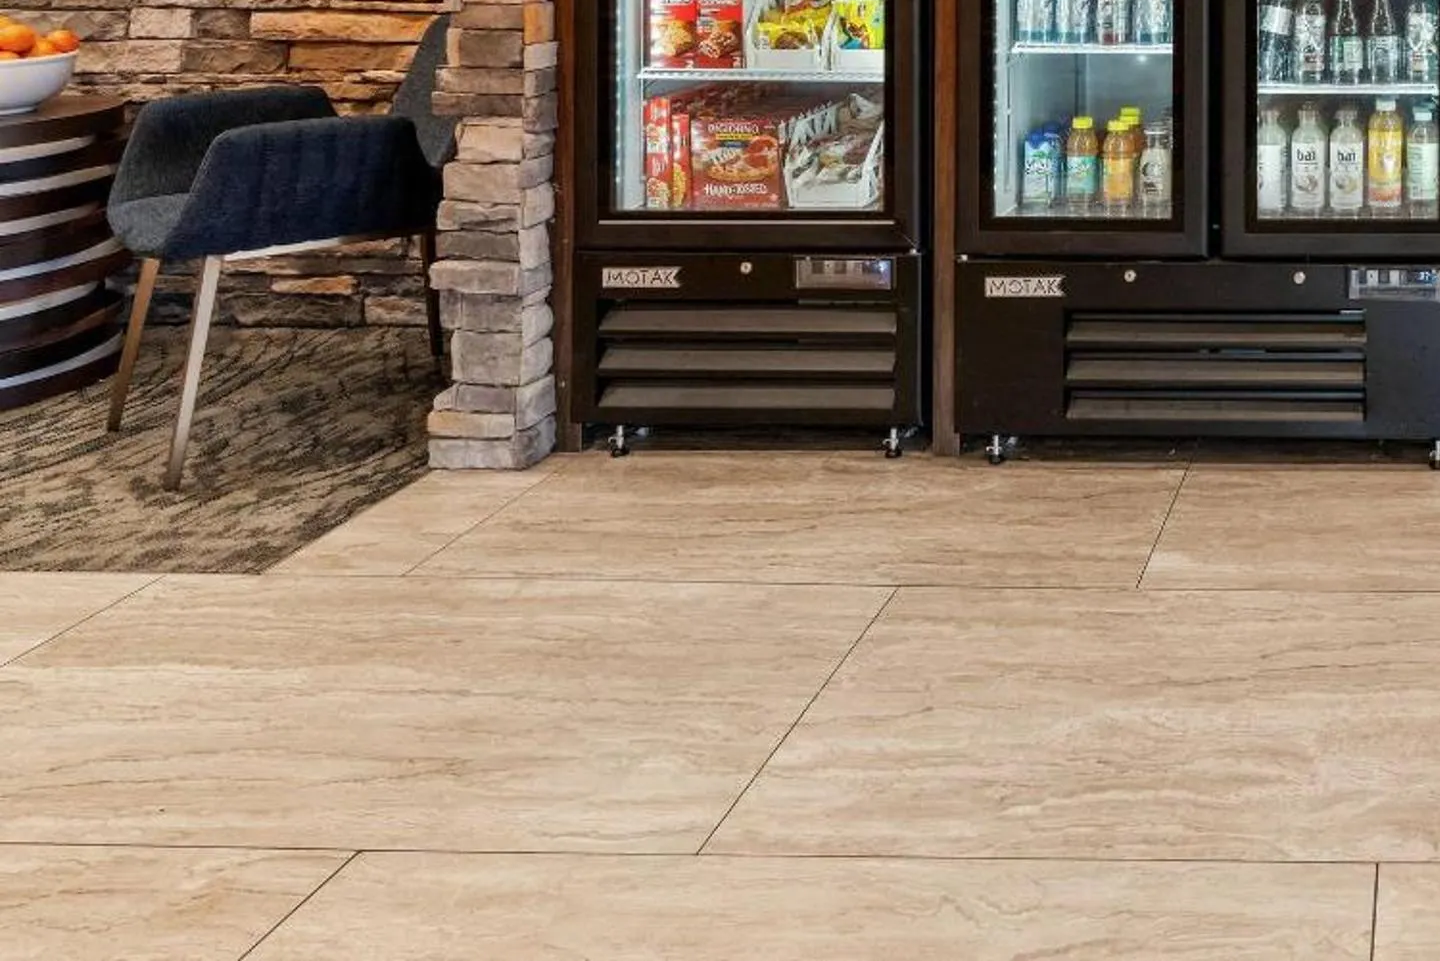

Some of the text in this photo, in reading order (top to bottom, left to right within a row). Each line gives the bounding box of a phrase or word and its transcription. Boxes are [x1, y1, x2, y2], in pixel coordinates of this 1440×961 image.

[1296, 148, 1316, 161] bai
[606, 269, 675, 286] MOTAK
[989, 277, 1060, 296] MOTAK
